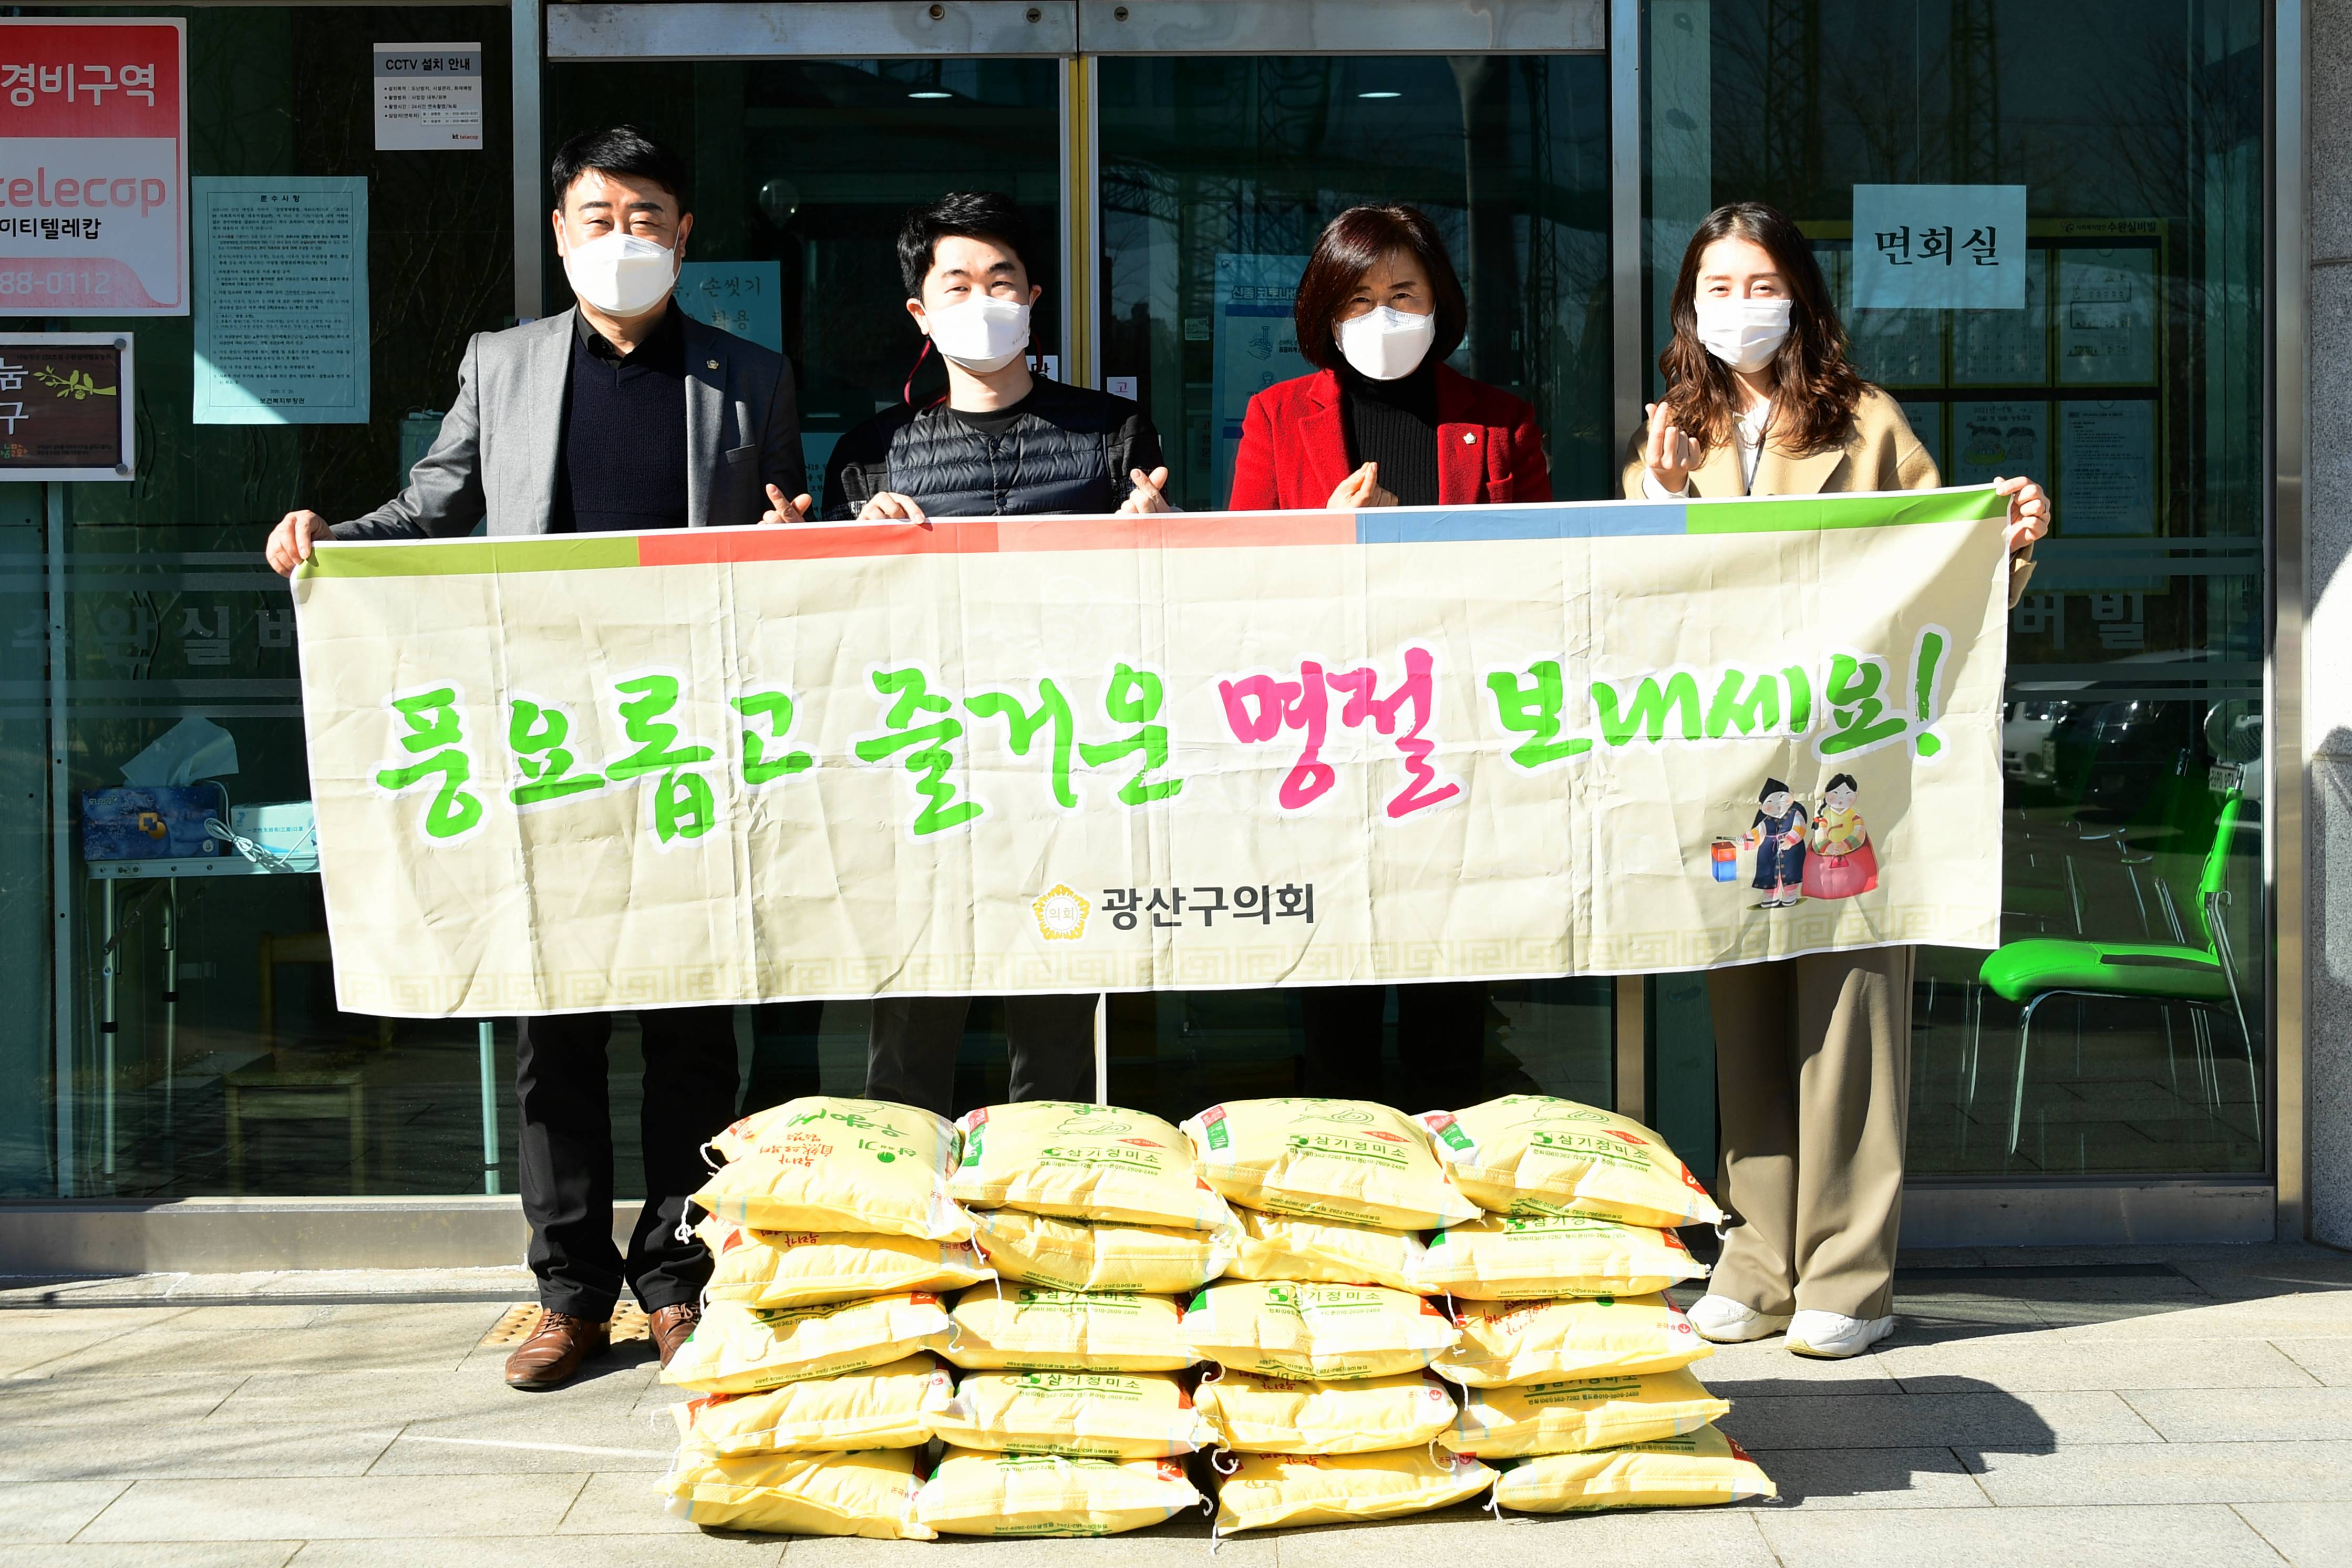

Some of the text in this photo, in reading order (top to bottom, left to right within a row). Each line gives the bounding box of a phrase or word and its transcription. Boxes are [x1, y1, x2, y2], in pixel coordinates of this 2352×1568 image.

[386, 58, 470, 71] CCTV 설치 안내
[1, 63, 156, 107] 경비구역
[2108, 221, 2157, 233] 수완실버빌
[1874, 225, 1999, 266] 면회실
[703, 276, 760, 298] 손씻기
[376, 632, 1942, 844] 풍요롭고 즐거운 명절 보내세요!
[1048, 906, 1075, 921] 의회
[1101, 883, 1314, 931] 광산구의회
[1066, 1148, 1161, 1163] 삼기정미소
[1315, 1136, 1406, 1158] 삼기정미소
[1558, 1134, 1649, 1160] 삼기정미소
[784, 1232, 820, 1248] 우리가
[1047, 1374, 1141, 1389] 삼기정미소
